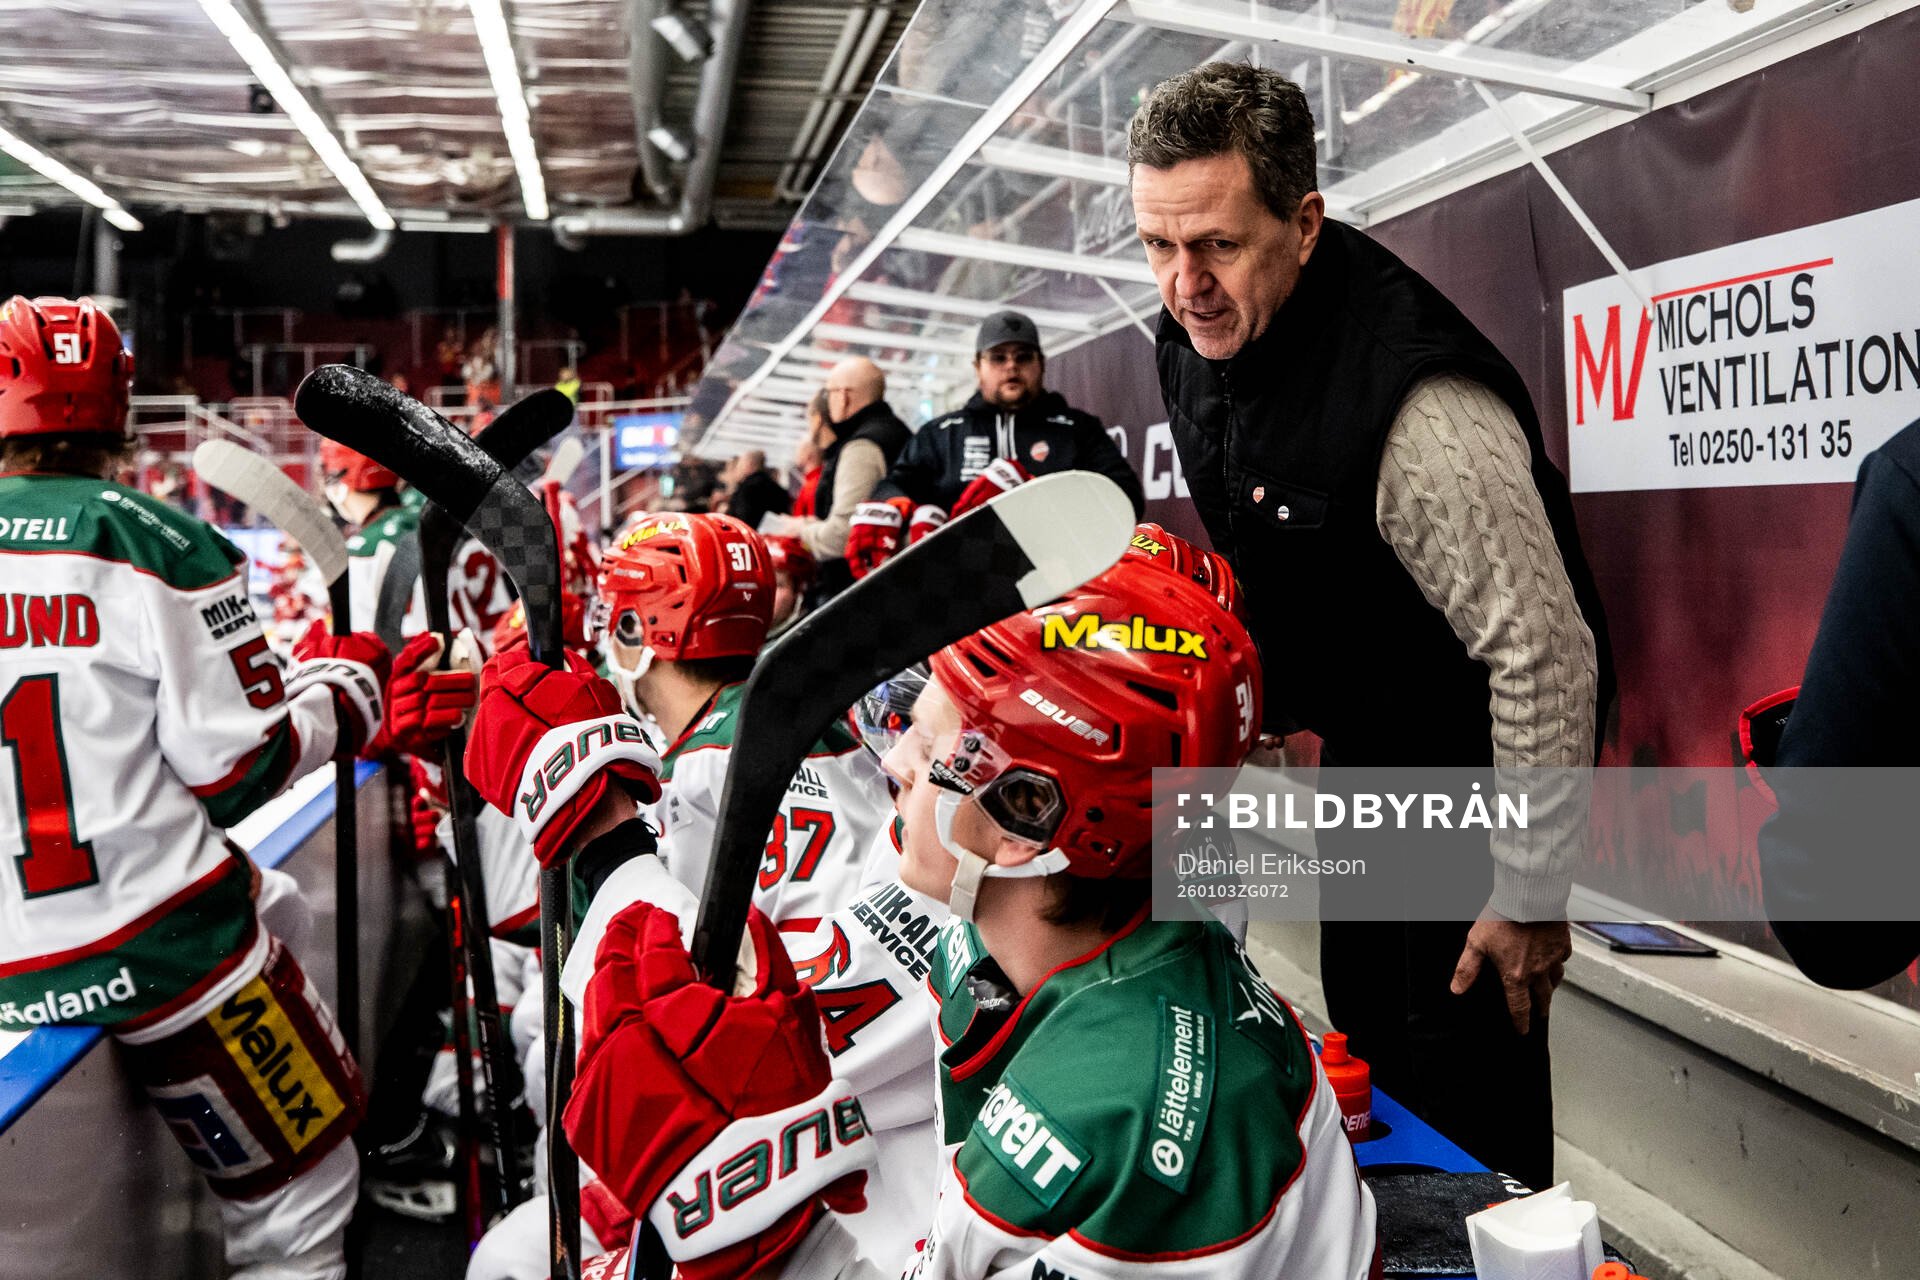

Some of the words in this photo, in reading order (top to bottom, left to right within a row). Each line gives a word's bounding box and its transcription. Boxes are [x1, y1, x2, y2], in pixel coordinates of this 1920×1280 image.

[1657, 272, 1815, 352] MICHOLS
[53, 333, 82, 364] 51
[1659, 329, 1920, 416] VENTILATION
[1669, 434, 1694, 467] Tel
[1700, 423, 1808, 465] 0250-131
[1821, 420, 1852, 458] 35
[726, 543, 752, 571] 37
[1041, 612, 1210, 660] Malux
[220, 993, 323, 1137] Malux
[1158, 1005, 1193, 1137] lättelement
